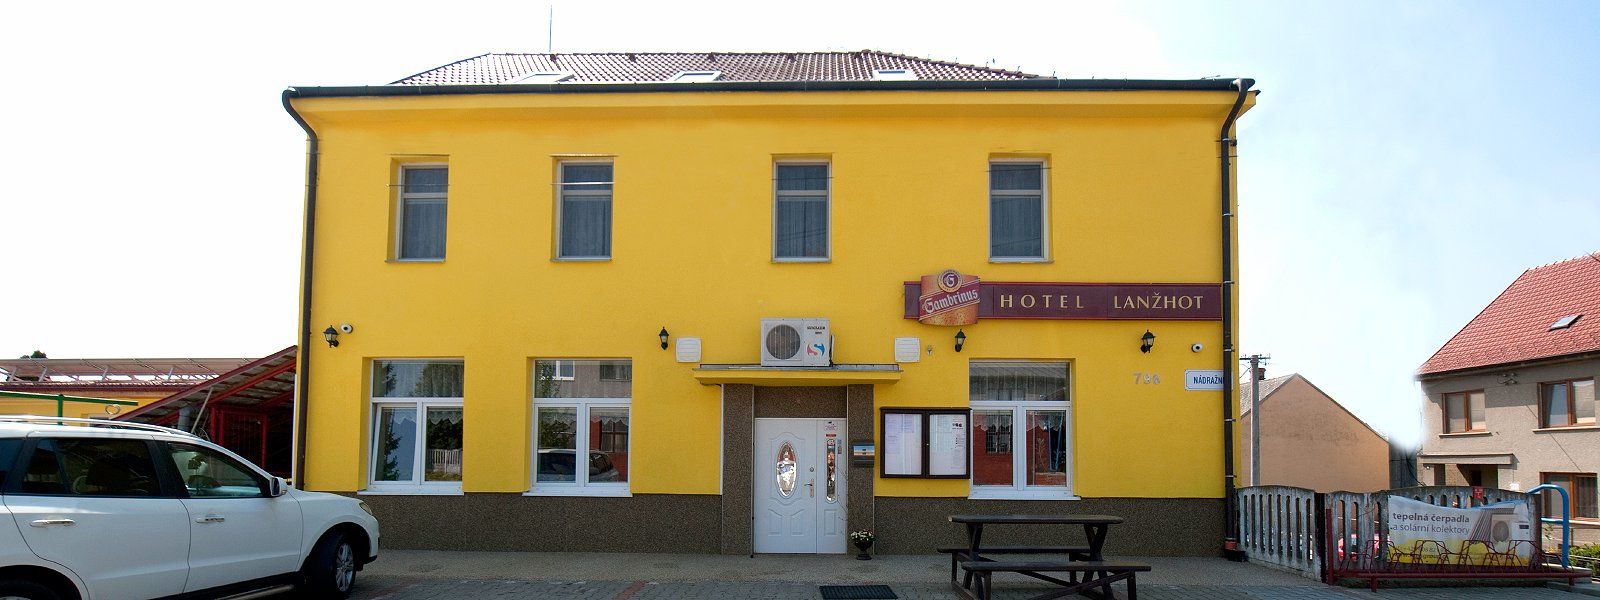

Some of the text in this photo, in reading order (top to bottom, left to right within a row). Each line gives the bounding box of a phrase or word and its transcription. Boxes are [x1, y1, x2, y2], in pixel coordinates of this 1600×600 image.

[922, 289, 978, 313] Gambrinus
[1000, 291, 1204, 309] HOTEL LANŽHOT
[1392, 512, 1470, 524] tepelná čerpadla
[1400, 523, 1429, 533] solární
[1431, 524, 1470, 535] kolektory
